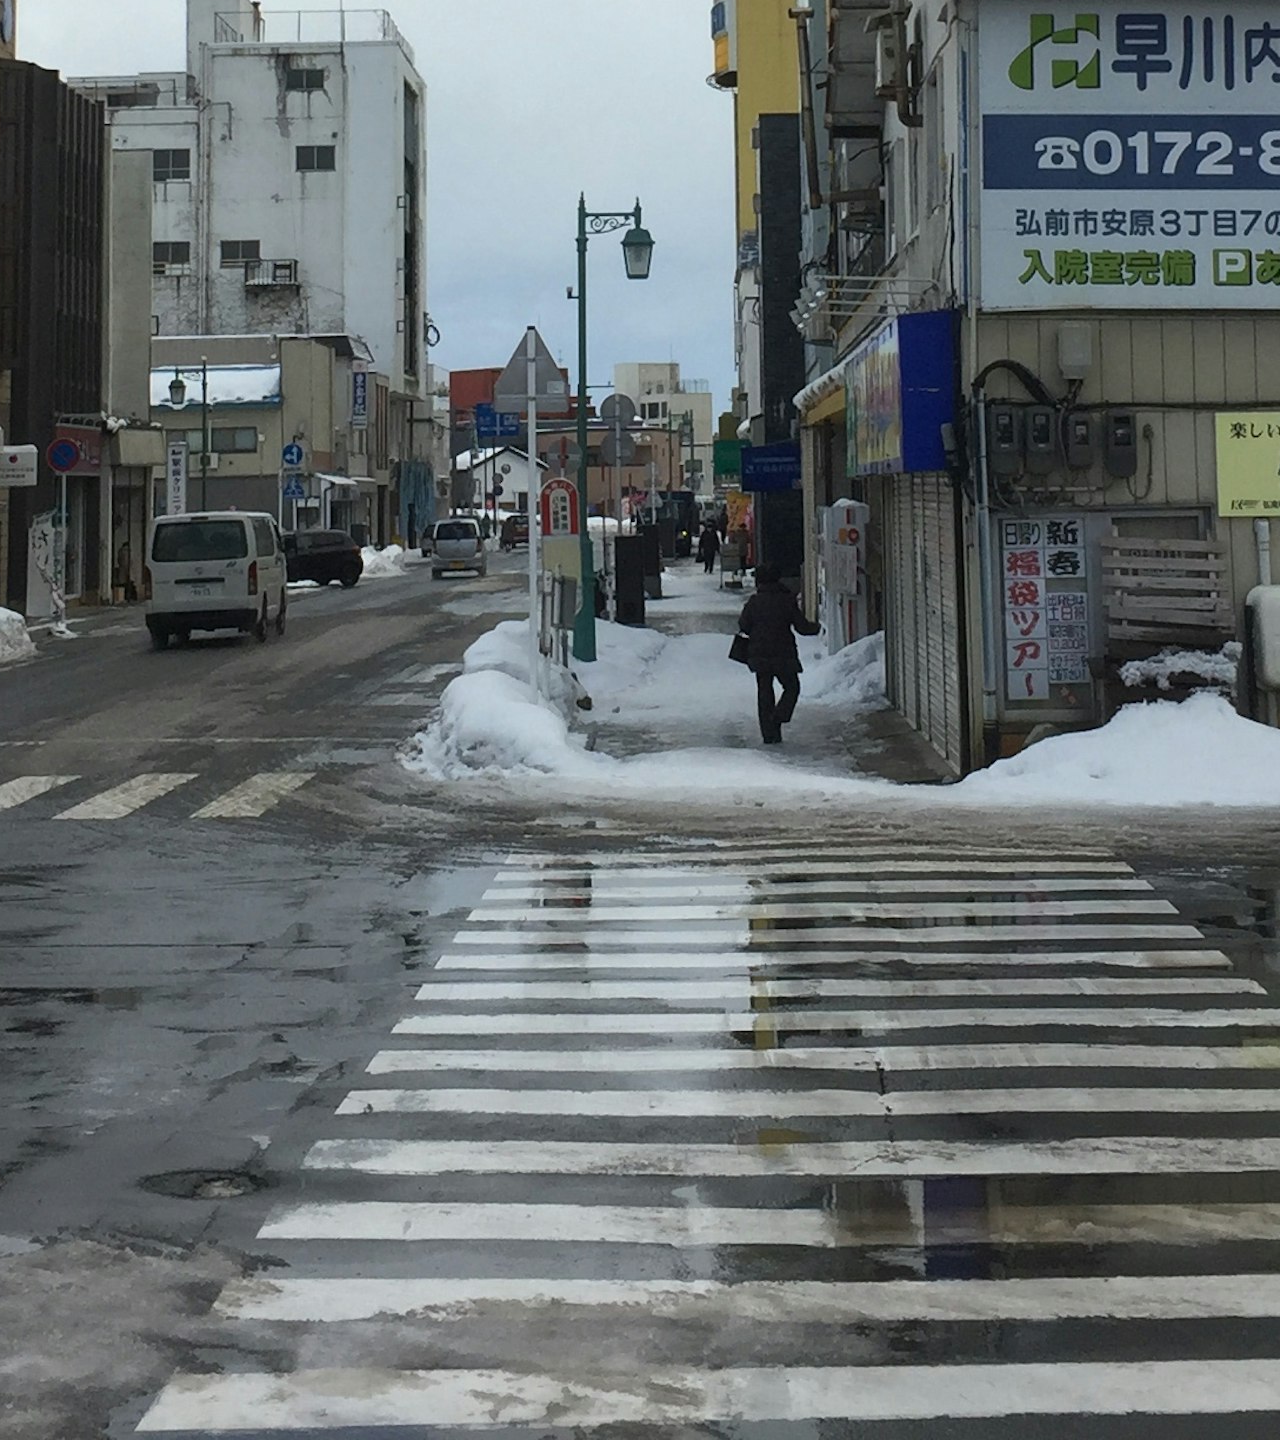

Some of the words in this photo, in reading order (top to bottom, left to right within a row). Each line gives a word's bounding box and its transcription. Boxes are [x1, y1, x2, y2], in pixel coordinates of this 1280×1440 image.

[1018, 249, 1196, 286] 入院室完備
[1006, 550, 1042, 697] 福袋ツアー
